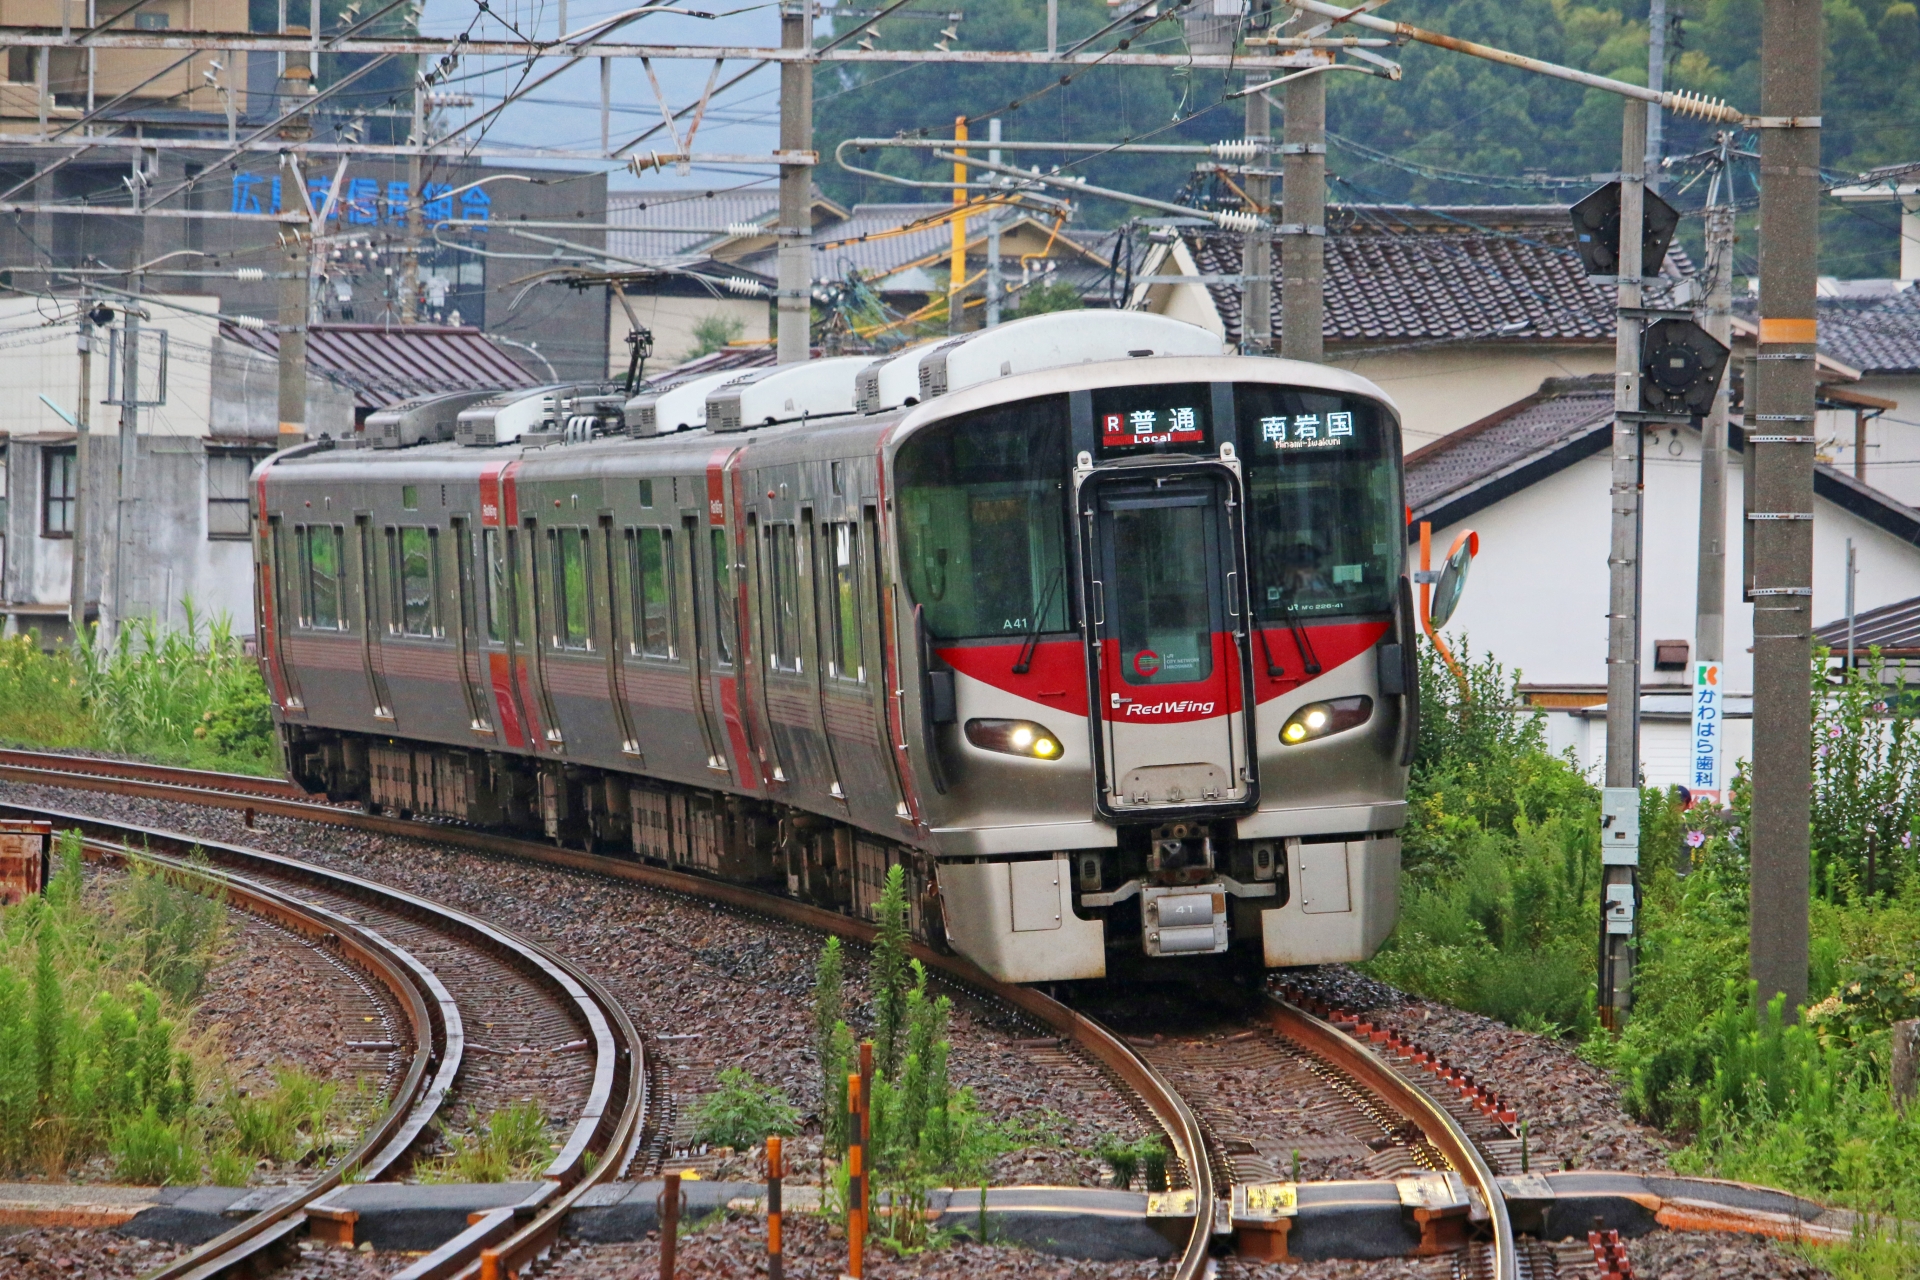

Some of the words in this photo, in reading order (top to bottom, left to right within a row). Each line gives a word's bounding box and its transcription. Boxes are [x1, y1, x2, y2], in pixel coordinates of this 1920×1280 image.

[1130, 408, 1196, 434] 普通
[1261, 411, 1353, 441] 南岩国
[1134, 432, 1171, 444] Local
[1275, 437, 1341, 449] Minami-Iwakuni
[1287, 603, 1299, 611] JR
[1003, 618, 1028, 630] A41
[1695, 689, 1716, 787] かわはら歯科
[1175, 905, 1194, 914] 41
